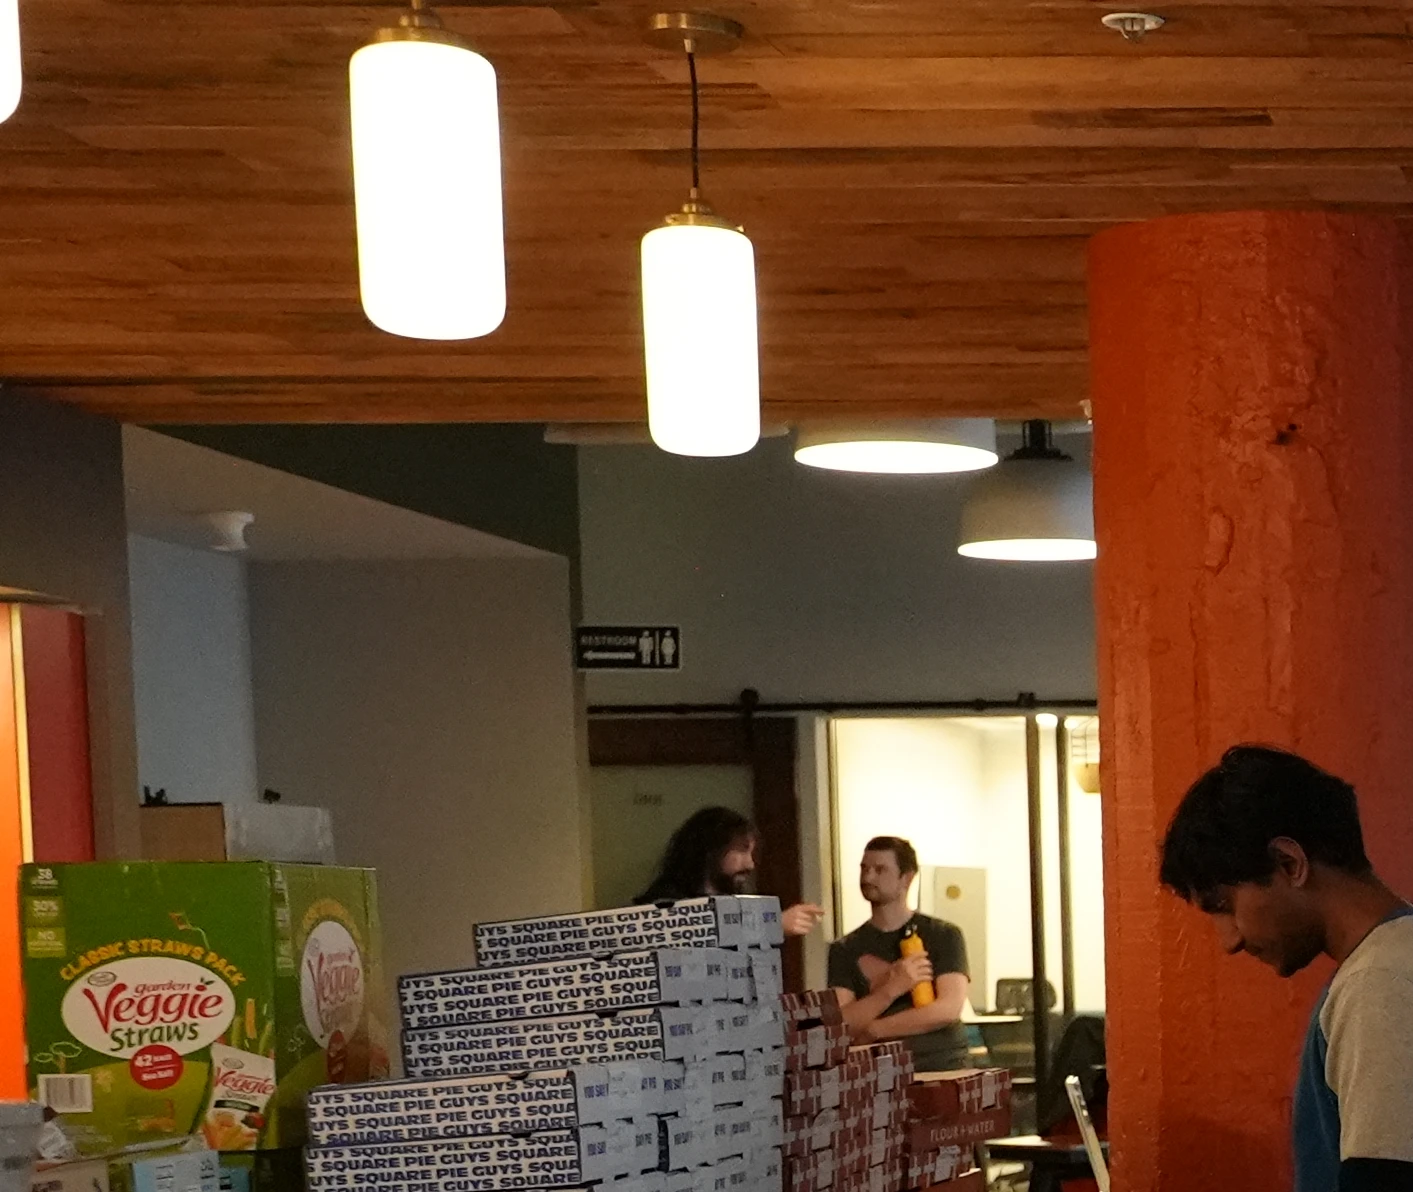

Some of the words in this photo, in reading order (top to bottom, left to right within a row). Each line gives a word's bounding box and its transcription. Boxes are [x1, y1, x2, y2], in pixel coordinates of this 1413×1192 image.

[487, 932, 557, 947] SQUARE
[560, 928, 588, 939] PIE
[592, 923, 636, 936] GUYS
[642, 915, 713, 931] SQUARE
[515, 941, 585, 957] SQUARE
[588, 937, 617, 949] PIE
[621, 932, 665, 946] GUYS
[60, 941, 125, 981] CLASSIC
[128, 938, 205, 961] STRAWS
[203, 951, 247, 987] PACK
[134, 979, 191, 998] garden
[412, 984, 488, 1000] SQUARE
[491, 980, 521, 992] PIE
[526, 975, 573, 988] GUYS
[579, 966, 656, 983] SQUARE
[82, 983, 223, 1034] Veggie
[419, 1009, 496, 1024] SQUARE
[501, 1006, 525, 1016] PIE
[530, 1001, 577, 1014] GUYS
[583, 992, 659, 1008] SQUARE
[443, 994, 519, 1011] SQUARE
[522, 990, 553, 1003] PIE
[556, 985, 604, 999] GUYS
[110, 1022, 200, 1052] Straws
[419, 1039, 492, 1054] SQUARE
[496, 1037, 525, 1047] PIE
[529, 1032, 578, 1045] GUYS
[583, 1026, 658, 1040] SQUARE
[448, 1050, 523, 1064] SQUARE
[526, 1047, 556, 1058] PIE
[560, 1043, 608, 1055] GUYS
[322, 1101, 400, 1117] SQUARE
[403, 1099, 436, 1110] PIE
[439, 1094, 489, 1108] GUYS
[494, 1088, 574, 1103] SQUARE
[354, 1113, 432, 1129] SQUARE
[435, 1111, 467, 1122] PIE
[471, 1106, 520, 1120] GUYS
[321, 1157, 401, 1172] SQUARE
[405, 1154, 436, 1166] PIE
[440, 1151, 490, 1164] GUYS
[496, 1145, 576, 1160] SQUARE
[353, 1169, 431, 1184] SQUARE
[435, 1167, 468, 1178] PIE
[471, 1163, 522, 1176] GUYS
[407, 1182, 439, 1192] PIE
[443, 1178, 493, 1190] GUYS
[500, 1172, 579, 1187] SQUARE
